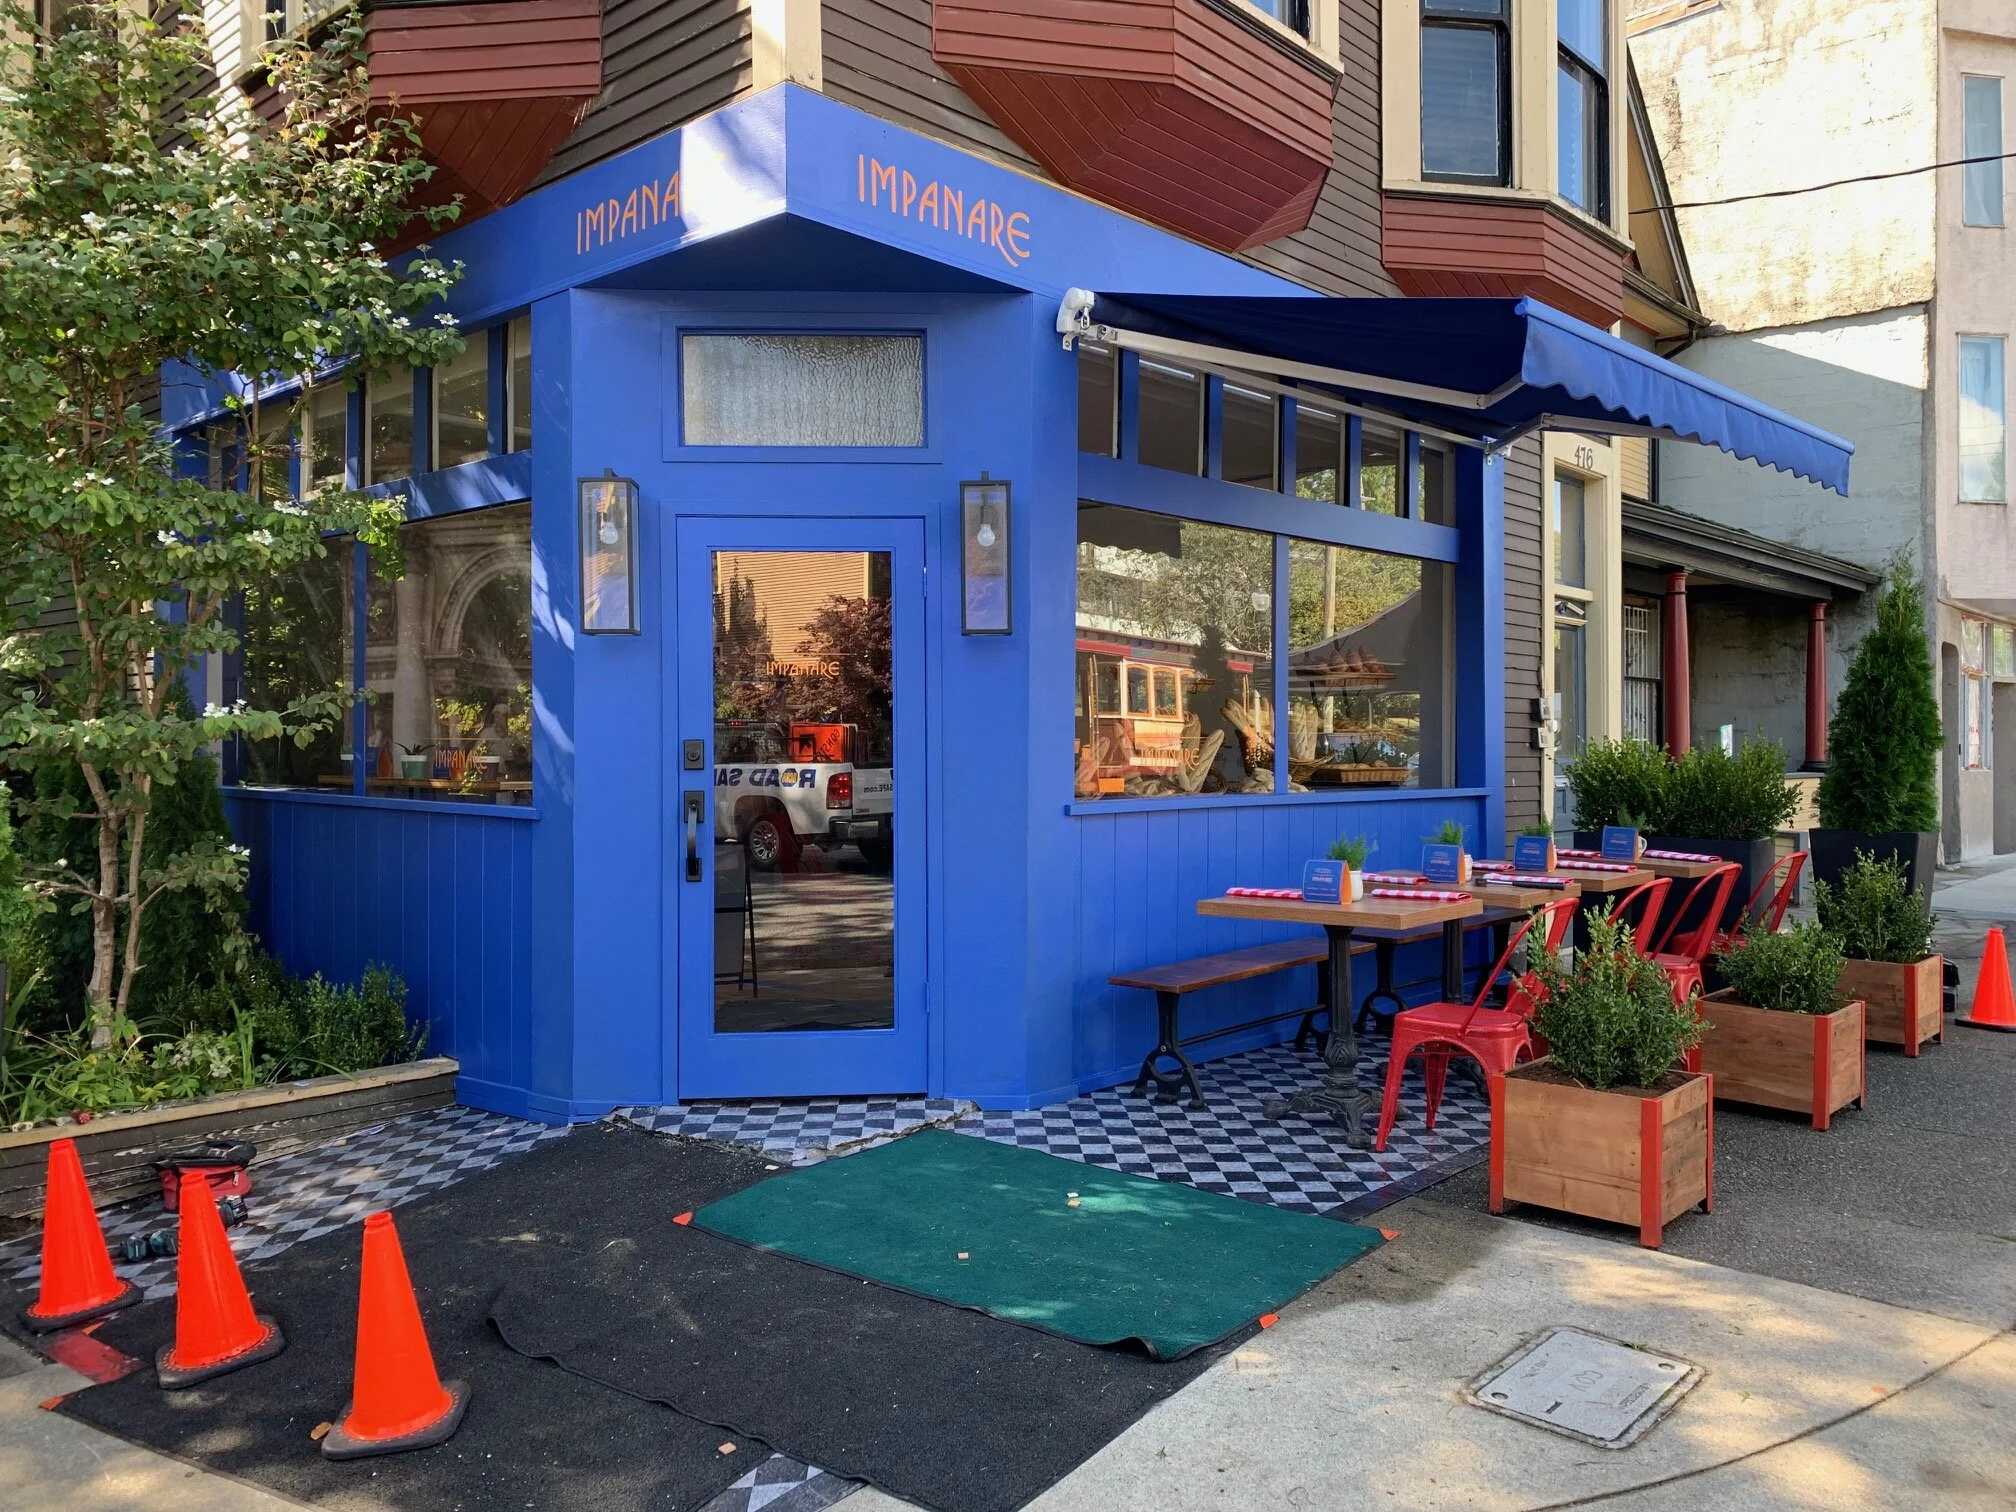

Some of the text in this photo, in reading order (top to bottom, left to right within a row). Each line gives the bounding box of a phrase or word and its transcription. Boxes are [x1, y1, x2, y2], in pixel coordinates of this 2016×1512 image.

[858, 154, 1031, 268] IMPANARE
[1574, 445, 1594, 470] 476
[766, 661, 840, 680] IMPANARE
[434, 749, 488, 774] IMPANARE
